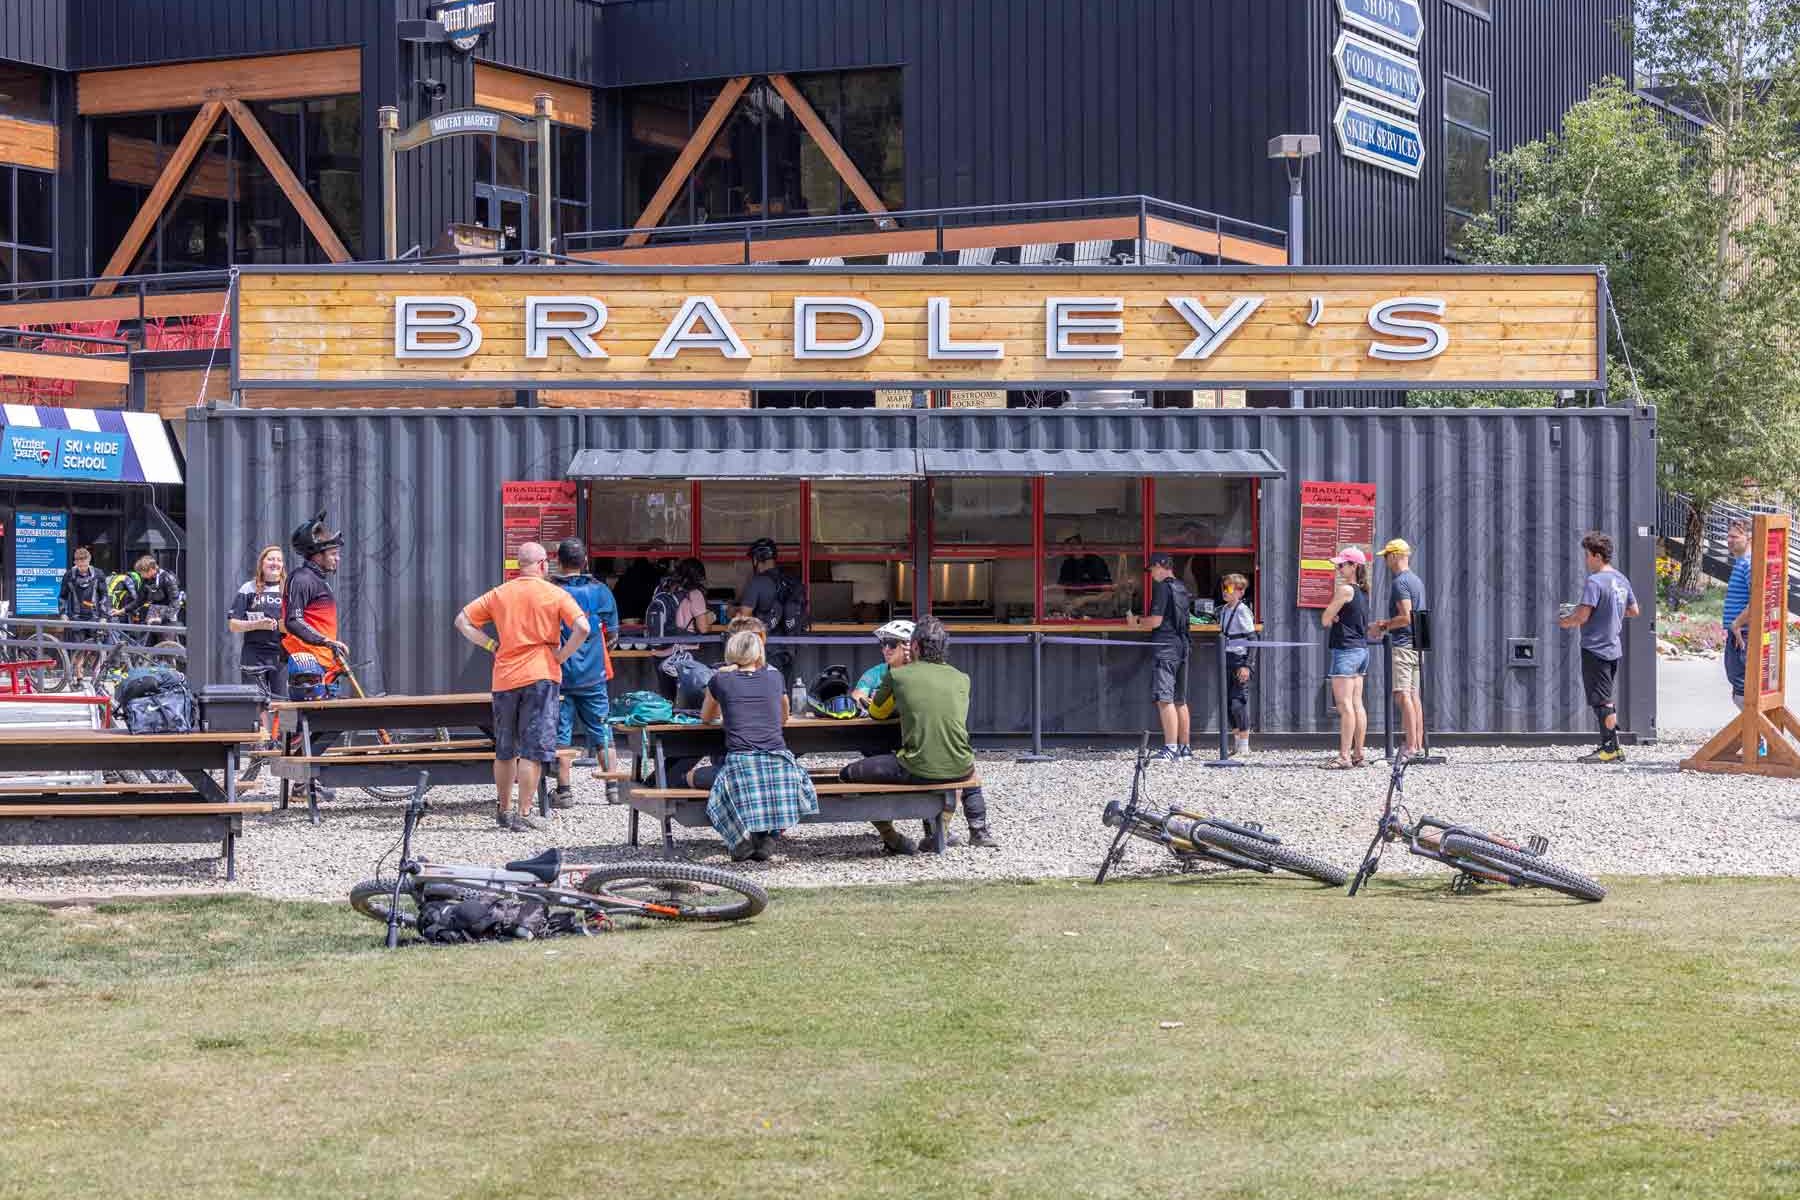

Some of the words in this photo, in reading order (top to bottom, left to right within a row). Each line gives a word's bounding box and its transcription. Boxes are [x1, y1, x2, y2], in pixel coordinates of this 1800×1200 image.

[1362, 0, 1400, 26] SHOPS
[1345, 50, 1374, 79] FOOD
[1375, 62, 1384, 83] &
[1385, 66, 1417, 97] DRINK
[434, 116, 463, 130] MOFFAT
[464, 113, 494, 127] MARKET
[1346, 118, 1375, 145] SKIER
[1376, 126, 1418, 160] SERVICES
[394, 295, 1450, 360] BRADLEY'S
[12, 437, 47, 451] Winter
[65, 440, 83, 454] SKI
[93, 442, 119, 455] RIDE
[14, 449, 41, 462] park
[63, 456, 107, 470] SCHOOL
